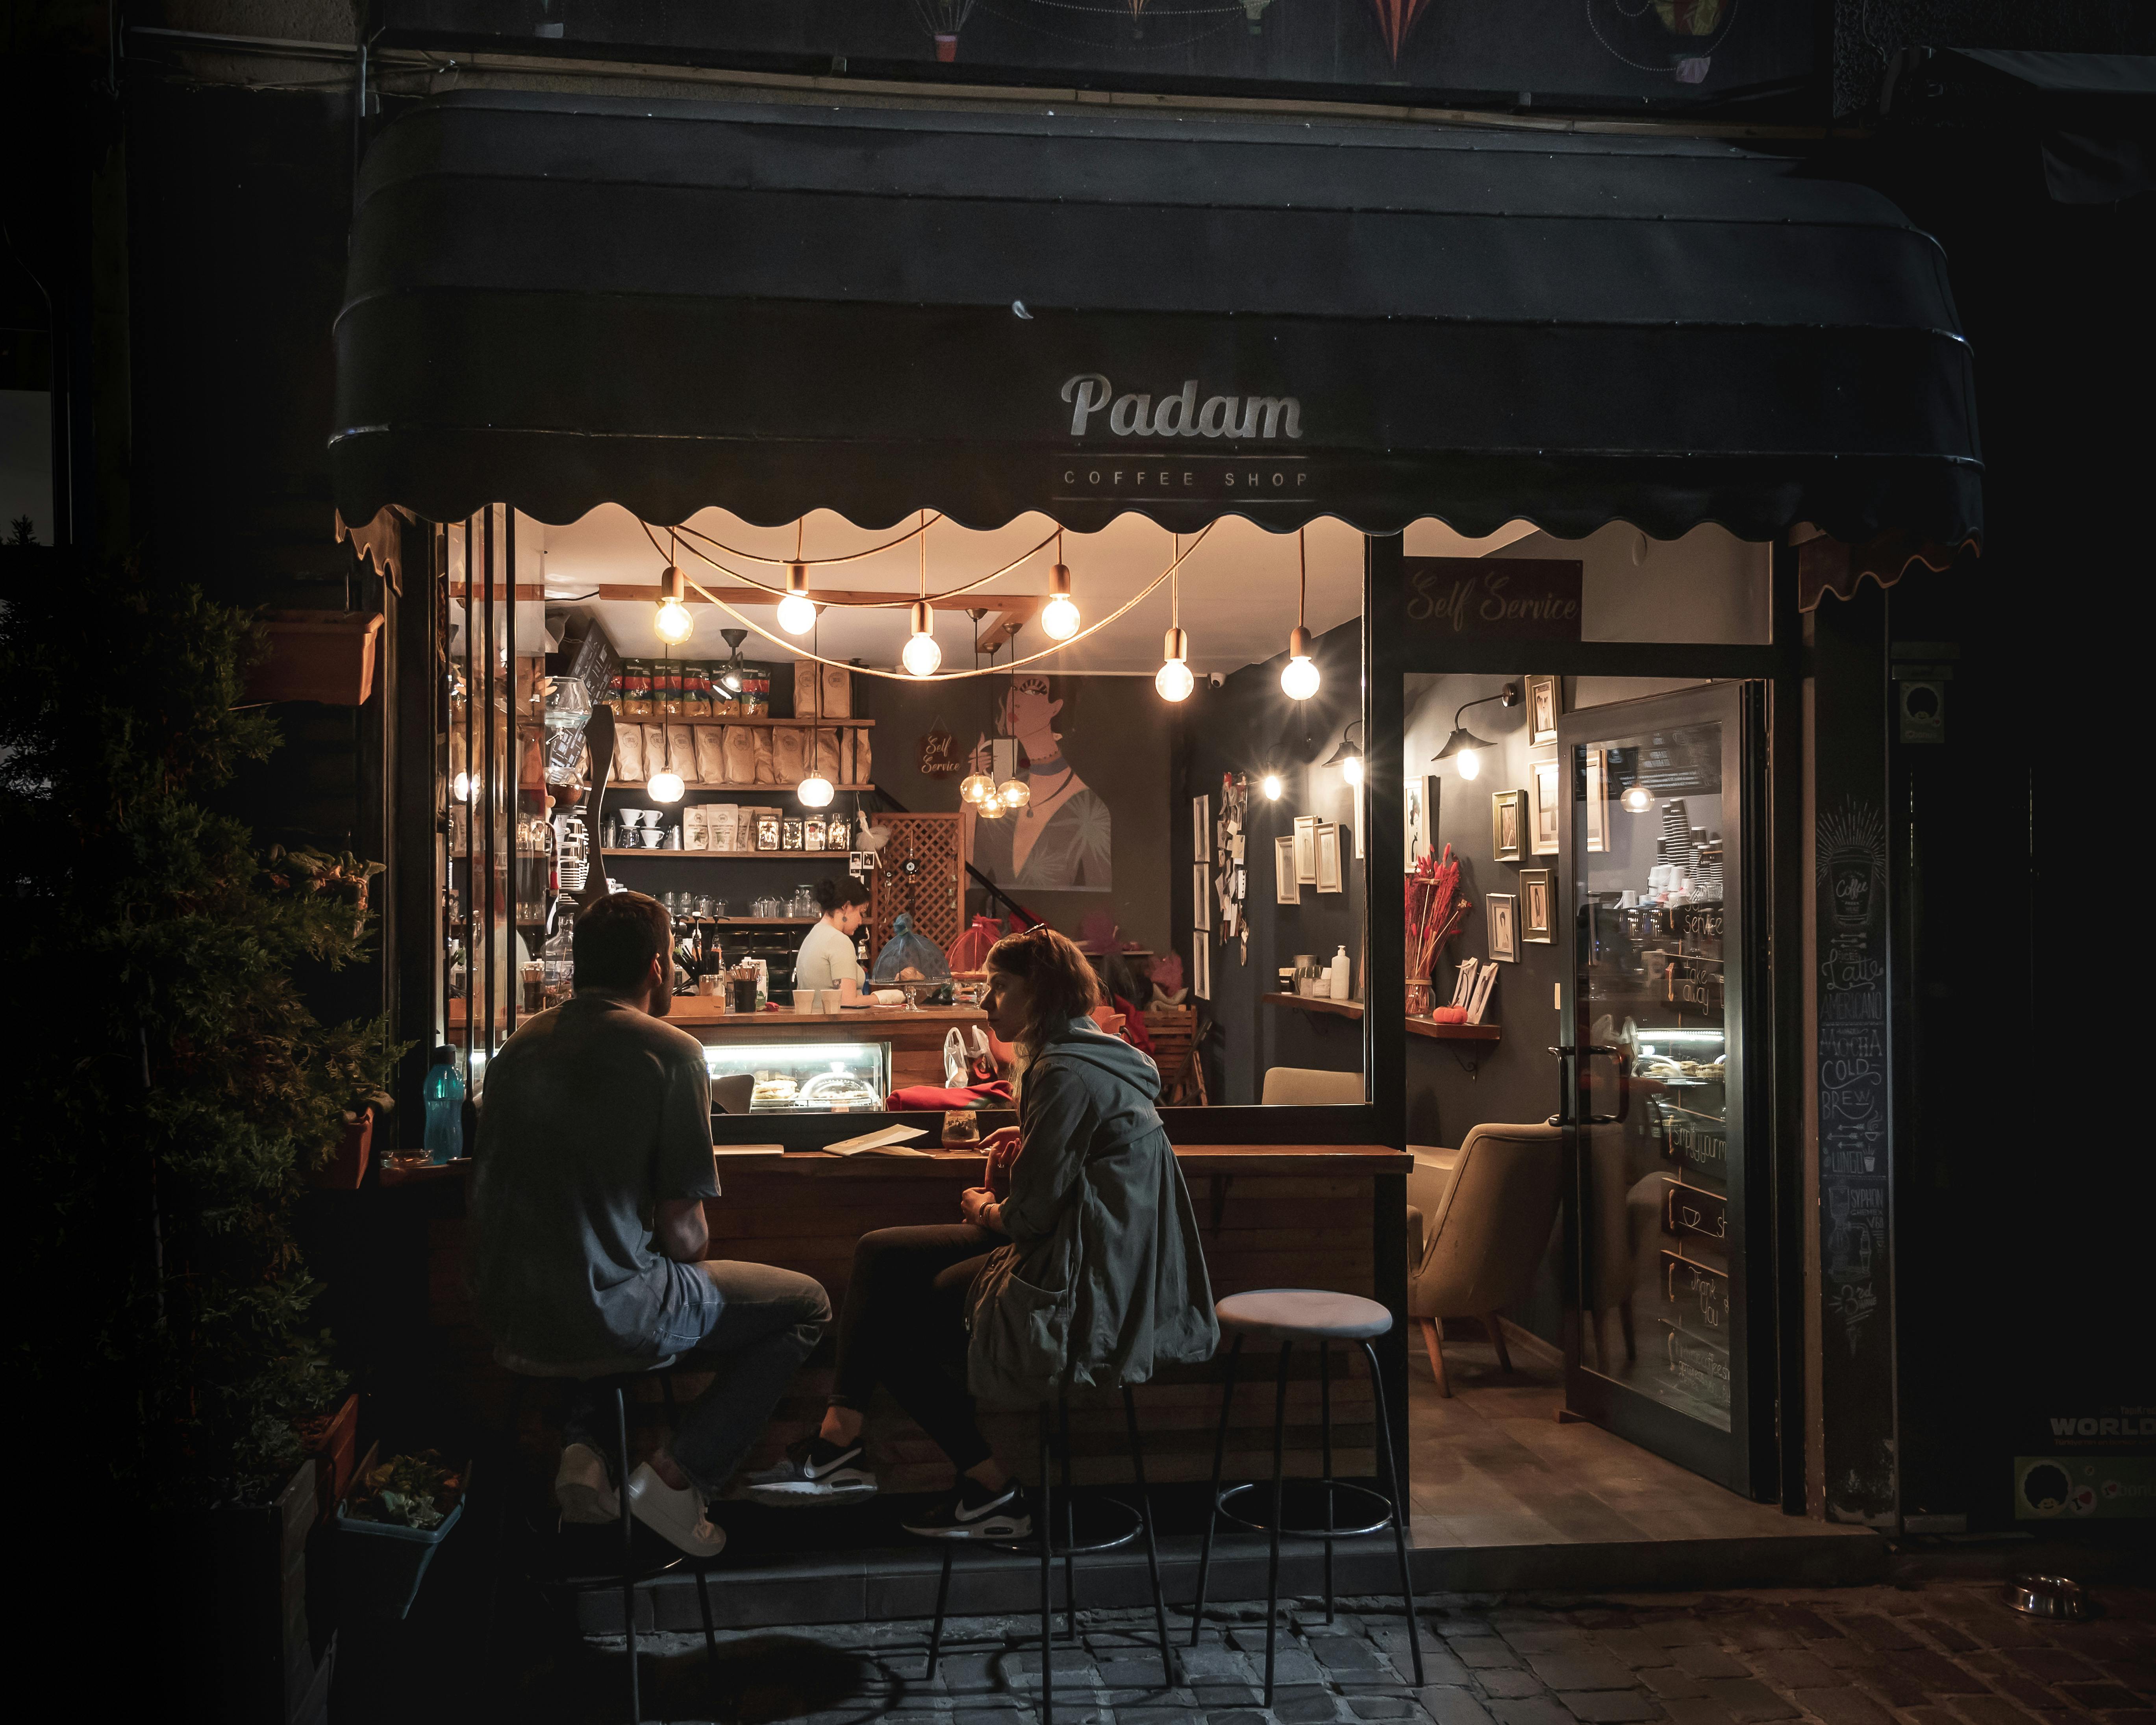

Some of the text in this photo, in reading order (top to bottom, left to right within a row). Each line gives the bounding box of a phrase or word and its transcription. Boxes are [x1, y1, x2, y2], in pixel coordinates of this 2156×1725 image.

[1061, 373, 1304, 439] Padam
[1064, 471, 1308, 487] COFFEE SHOP
[1406, 570, 1579, 632] Self Service
[925, 734, 952, 758] Self
[921, 754, 961, 774] Service
[1836, 878, 1868, 900] Coffee
[1821, 948, 1884, 991] Latte
[1820, 991, 1882, 1020] AMERICANO
[1821, 1089, 1874, 1120] BREW
[1850, 1188, 1884, 1209] SYPHON
[1689, 1266, 1716, 1300] Thank
[2050, 1417, 2156, 1436] WORLD
